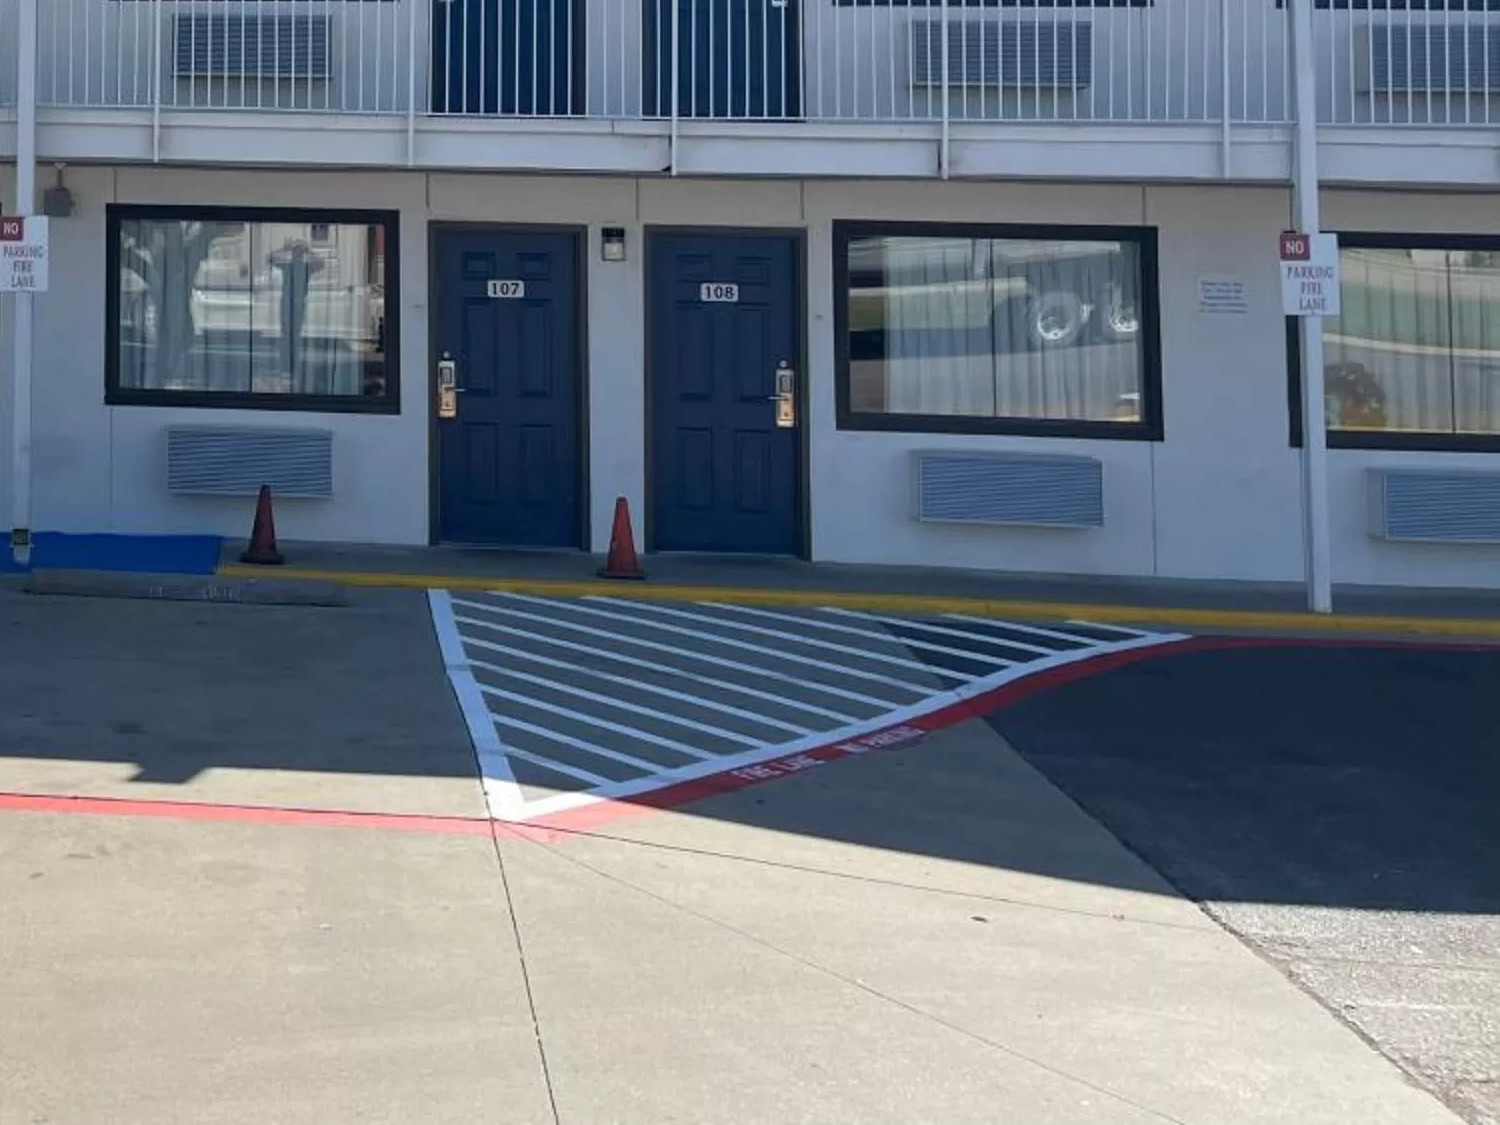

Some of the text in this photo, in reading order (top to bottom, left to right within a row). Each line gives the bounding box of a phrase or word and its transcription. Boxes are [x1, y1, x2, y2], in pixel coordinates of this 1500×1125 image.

[3, 221, 20, 235] NO
[3, 246, 44, 259] PARKING
[1285, 240, 1305, 255] NO
[13, 261, 34, 273] FIRE
[1286, 266, 1334, 280] PARKING
[11, 275, 37, 288] LANE
[492, 282, 520, 295] 107
[704, 285, 734, 300] 108
[1300, 282, 1323, 295] FIRE
[1299, 297, 1327, 310] LANE
